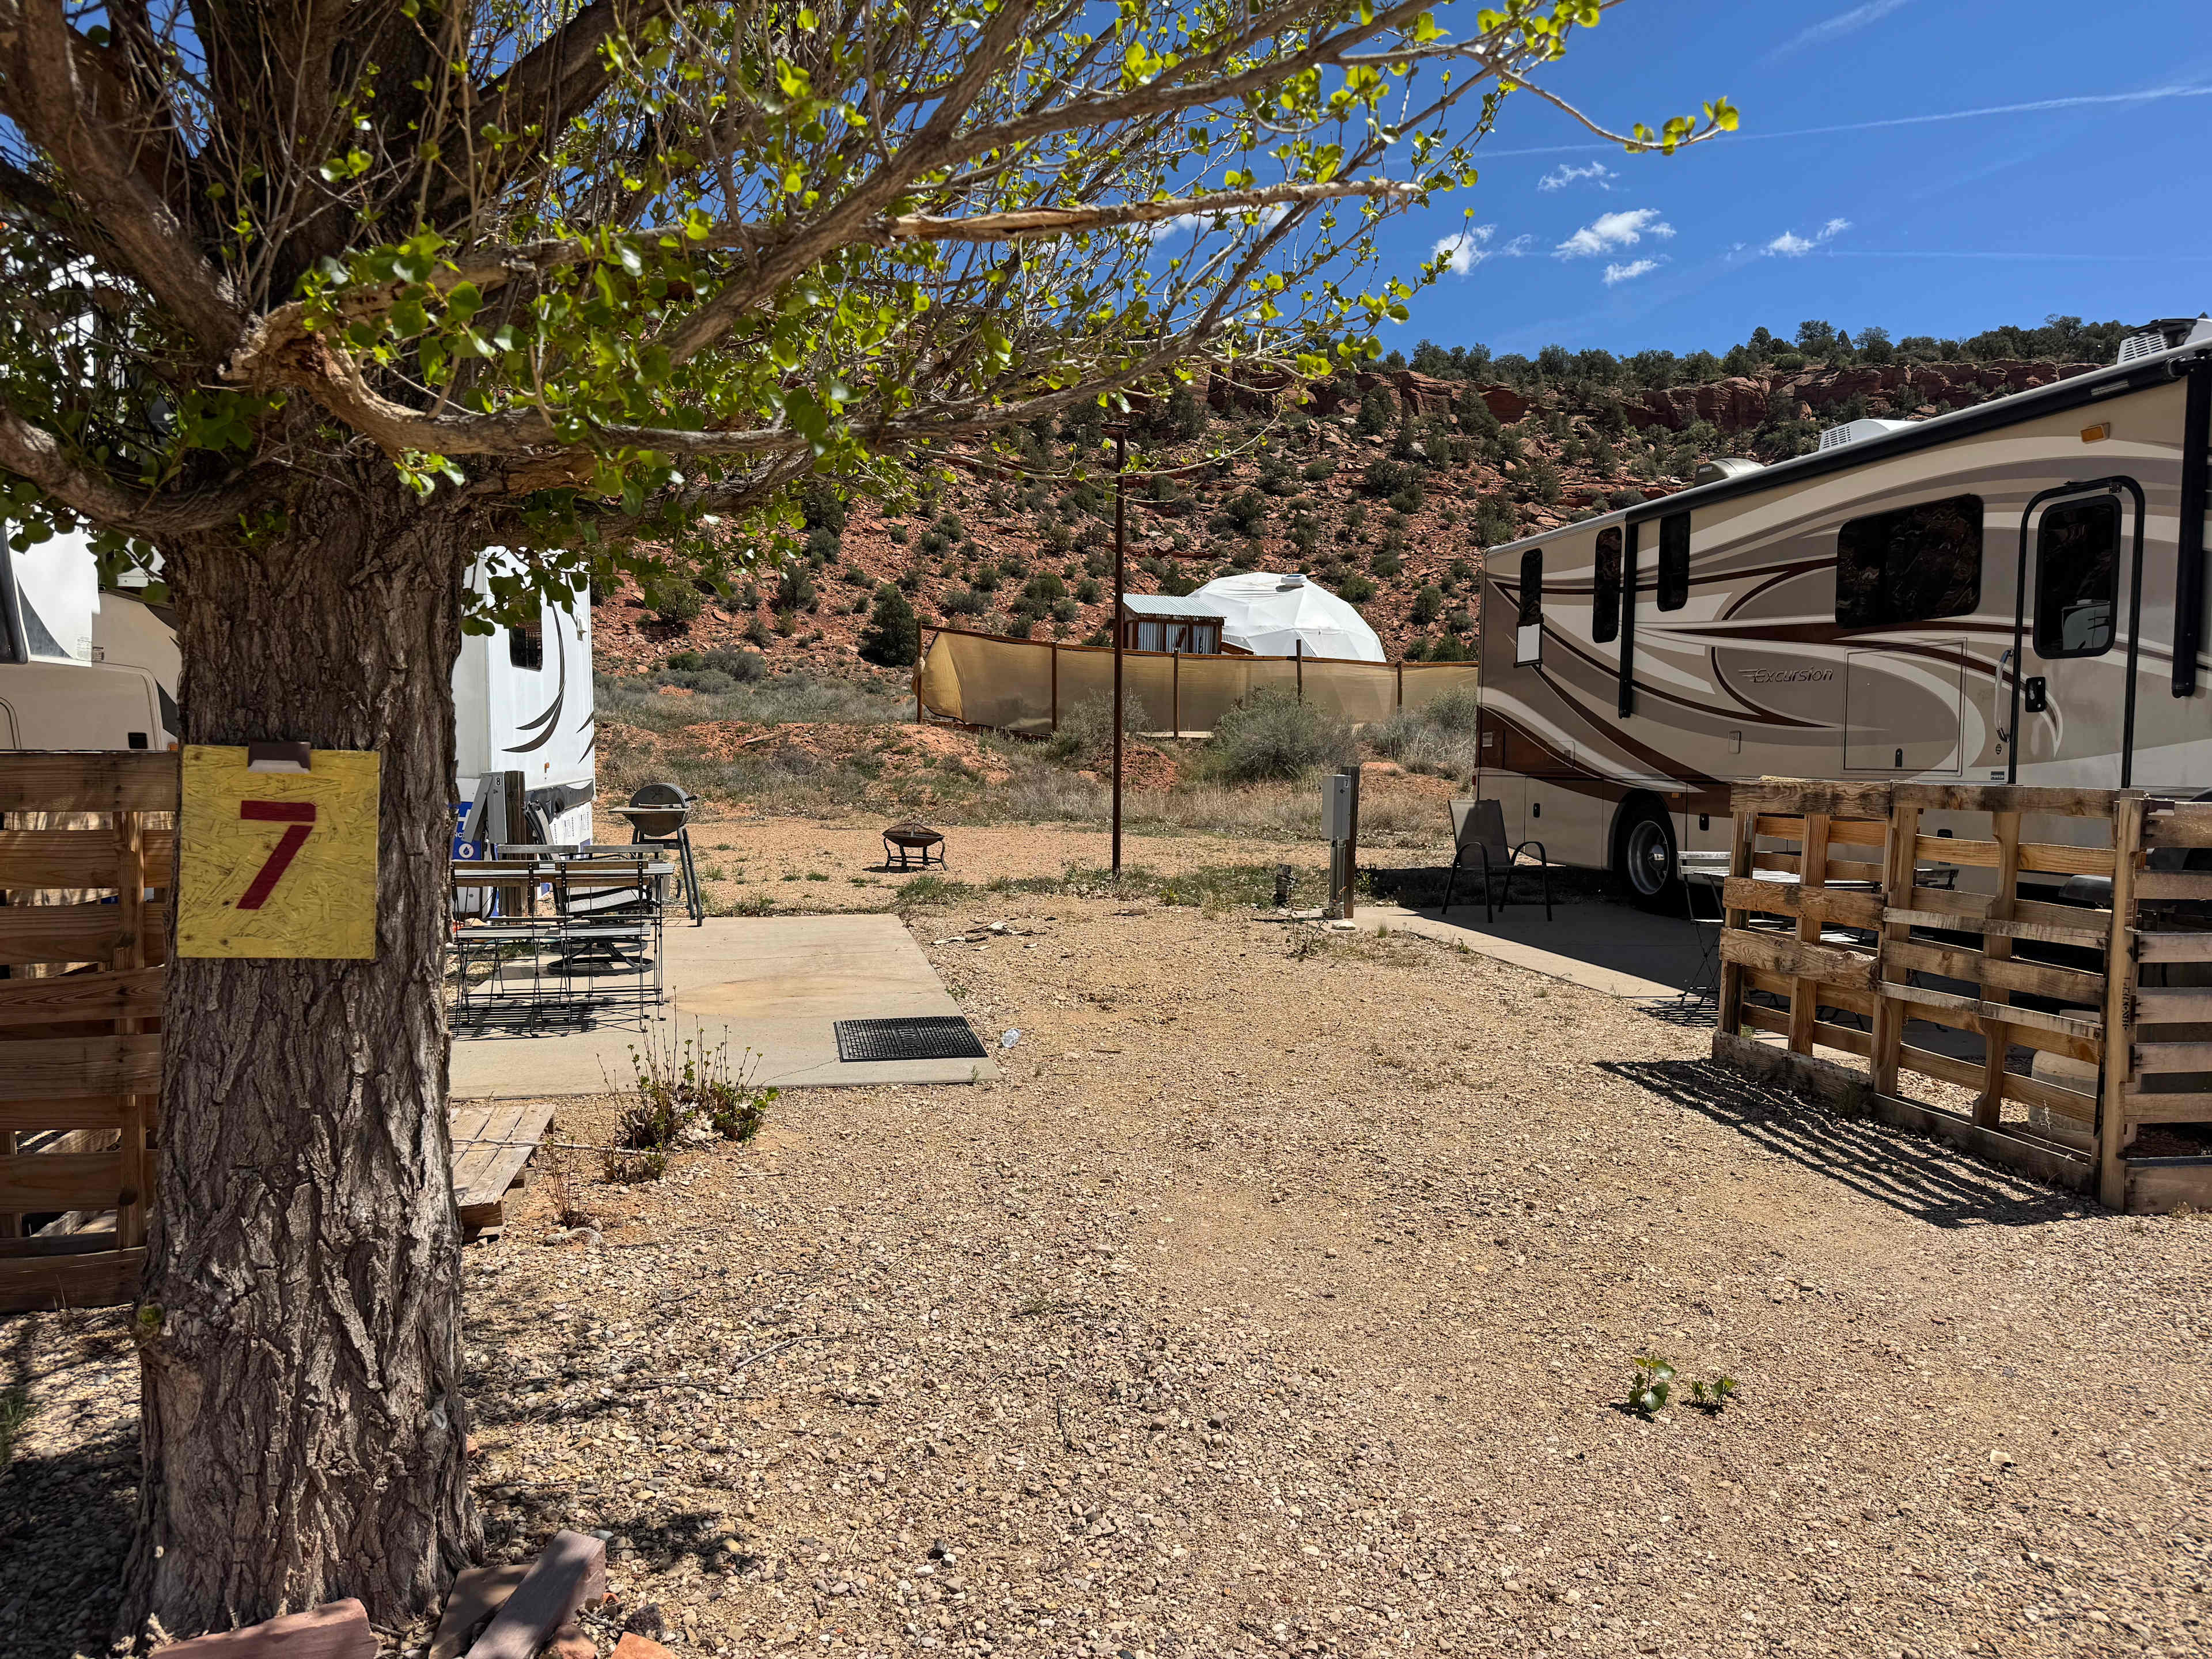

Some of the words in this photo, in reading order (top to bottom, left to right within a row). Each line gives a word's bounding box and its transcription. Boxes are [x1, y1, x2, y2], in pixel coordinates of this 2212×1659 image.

[1753, 666, 1834, 683] Excursion
[496, 777, 501, 785] 8
[236, 800, 316, 910] 7
